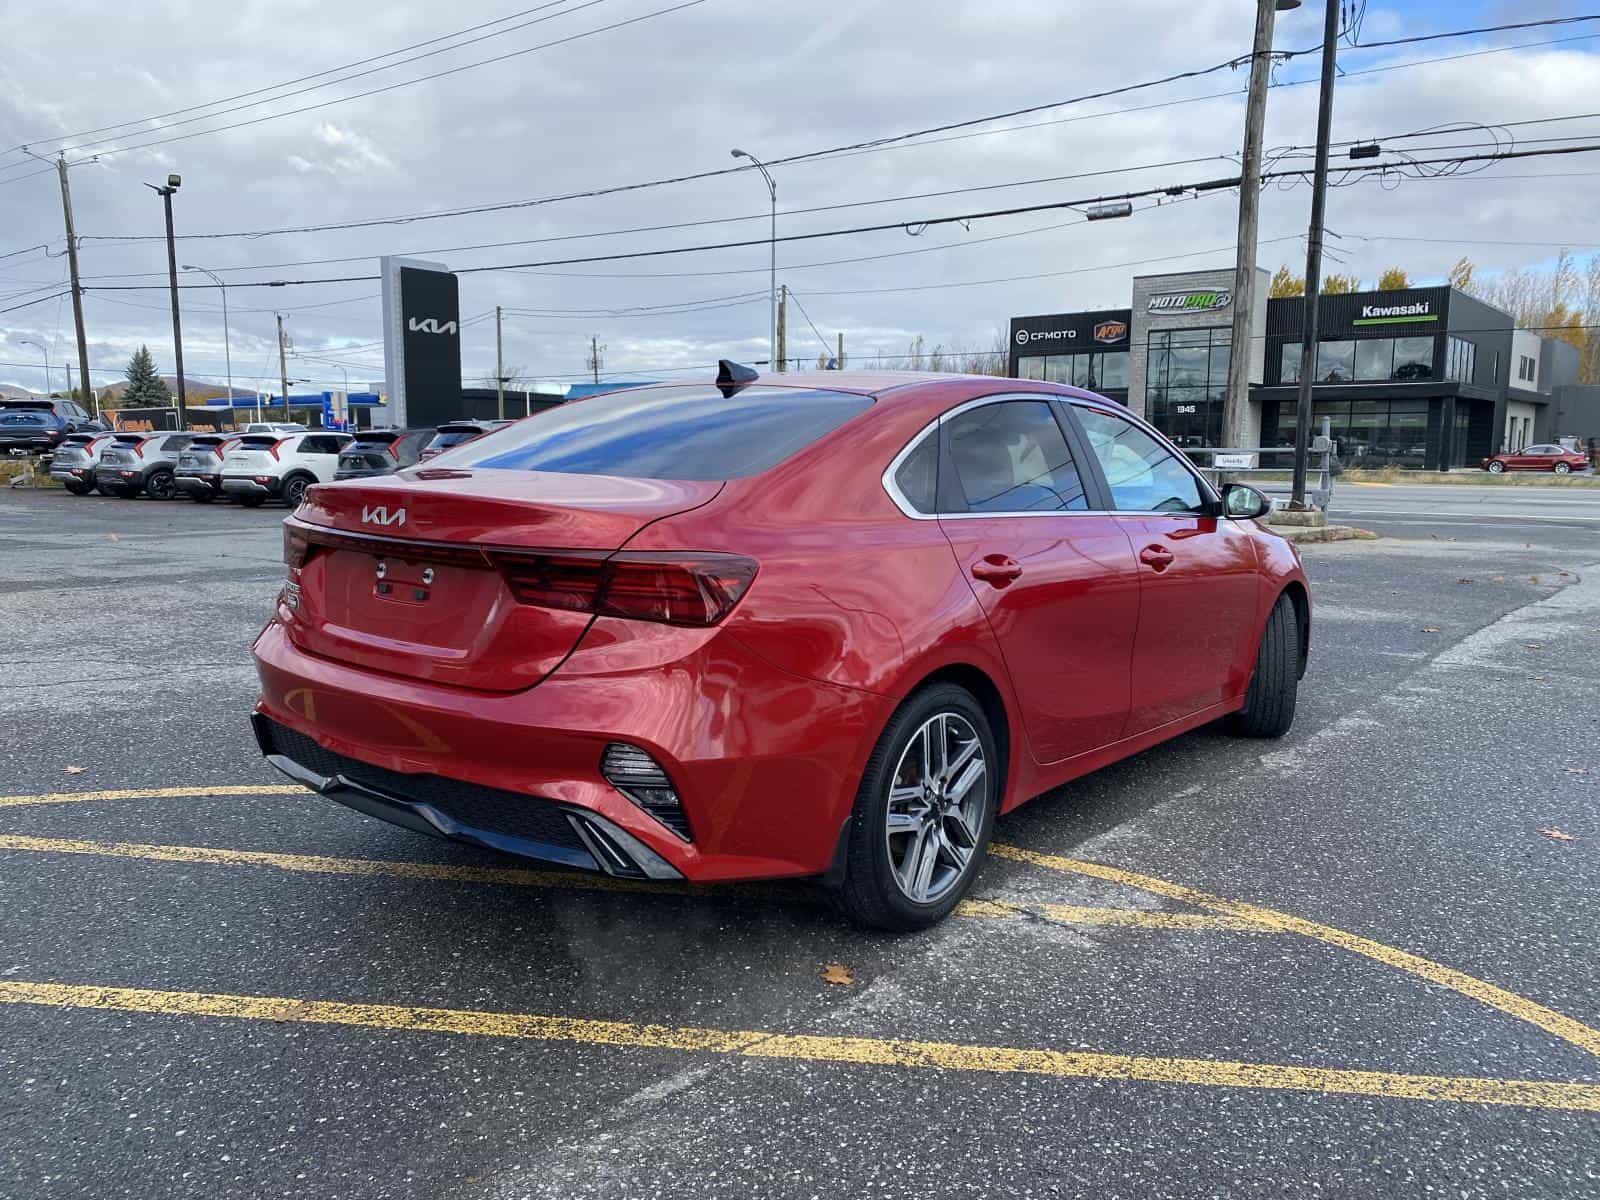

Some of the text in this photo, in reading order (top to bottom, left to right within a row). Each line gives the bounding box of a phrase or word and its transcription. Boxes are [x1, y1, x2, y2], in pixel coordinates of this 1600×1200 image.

[1362, 302, 1429, 317] Kawasaki
[409, 317, 456, 335] KIA
[1030, 330, 1077, 341] CFMOTO
[362, 504, 406, 526] KIA
